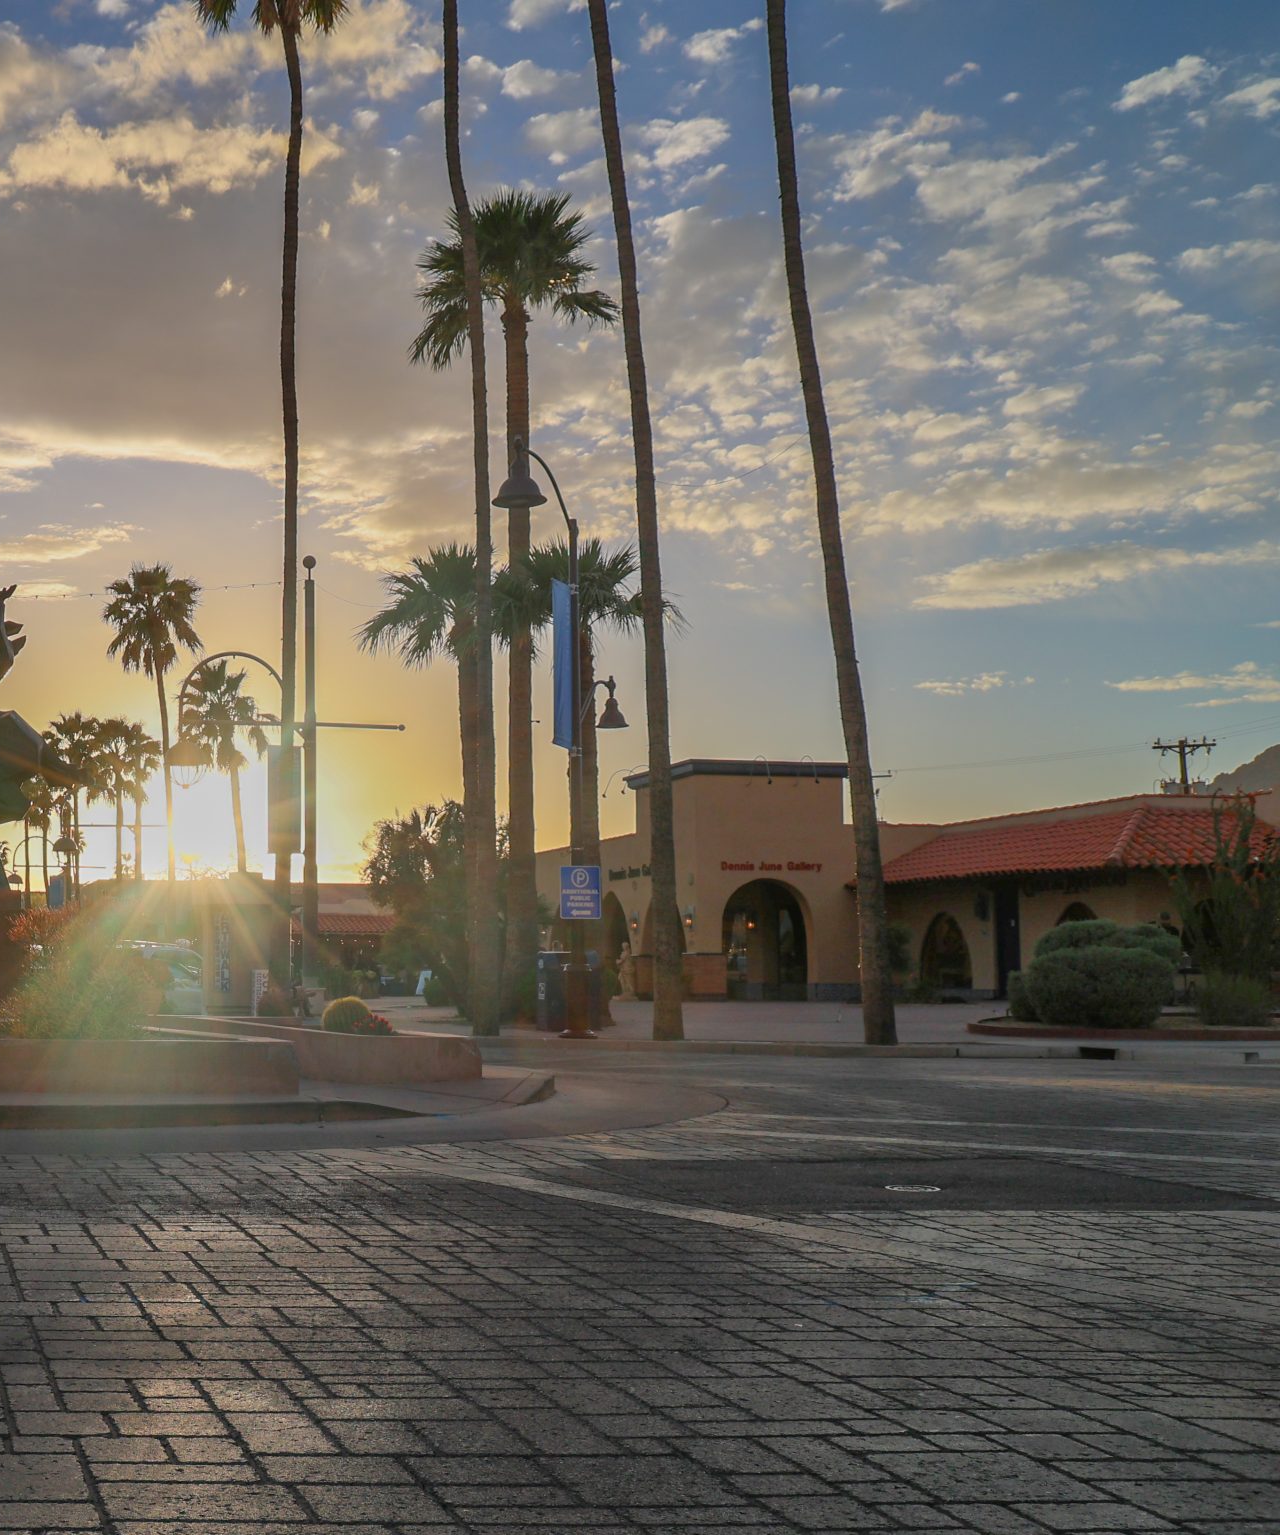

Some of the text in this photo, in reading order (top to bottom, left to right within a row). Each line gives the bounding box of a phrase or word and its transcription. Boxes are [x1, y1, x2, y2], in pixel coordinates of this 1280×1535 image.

[721, 861, 823, 873] Dennis June Gallery
[576, 871, 586, 884] P
